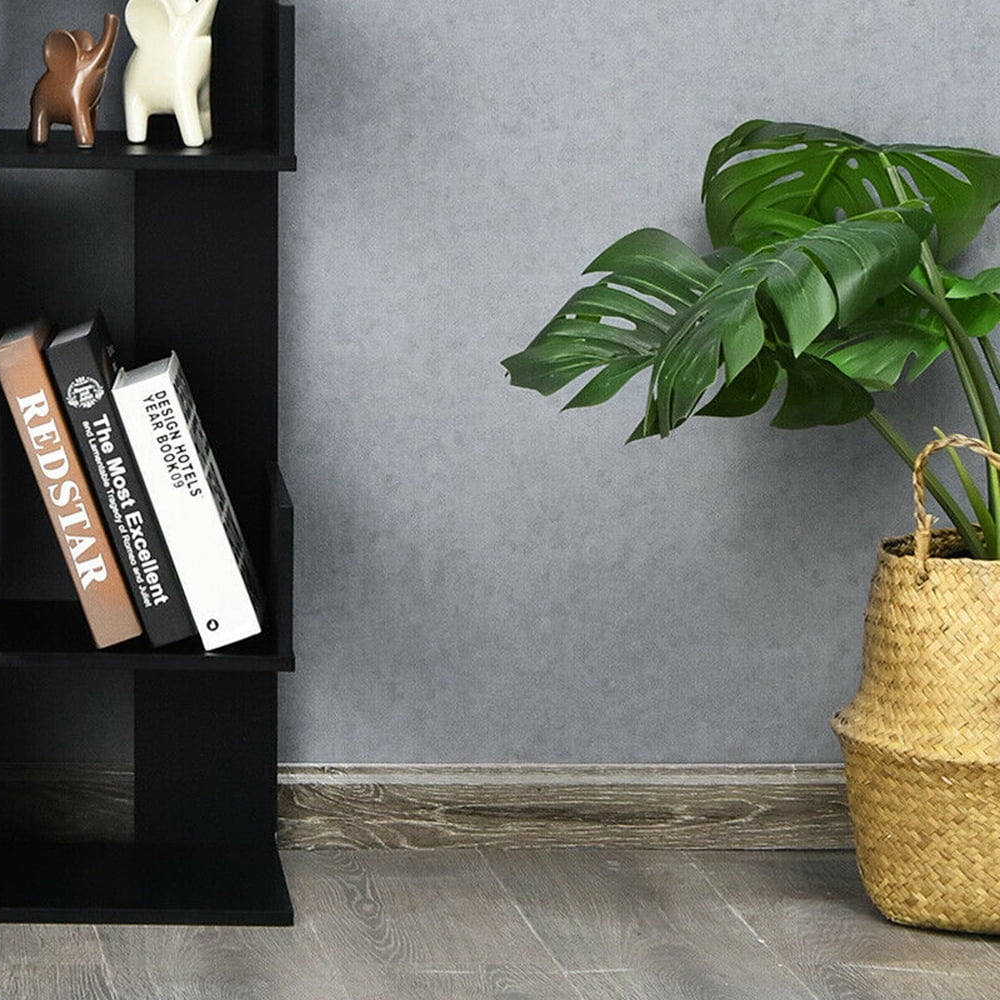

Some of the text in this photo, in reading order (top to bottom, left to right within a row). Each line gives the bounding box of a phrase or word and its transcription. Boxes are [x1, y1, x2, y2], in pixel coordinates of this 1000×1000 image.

[81, 420, 94, 438] and
[143, 394, 163, 432] YEAR
[155, 390, 201, 497] DESIGN HOTELS
[87, 438, 112, 488] Lamentable
[16, 389, 107, 590] REDSTAR
[103, 489, 124, 524] Tragedy
[93, 413, 168, 606] The Most Excellent
[121, 535, 138, 566] Romeo
[132, 566, 144, 584] and
[138, 584, 153, 608] Juliet
